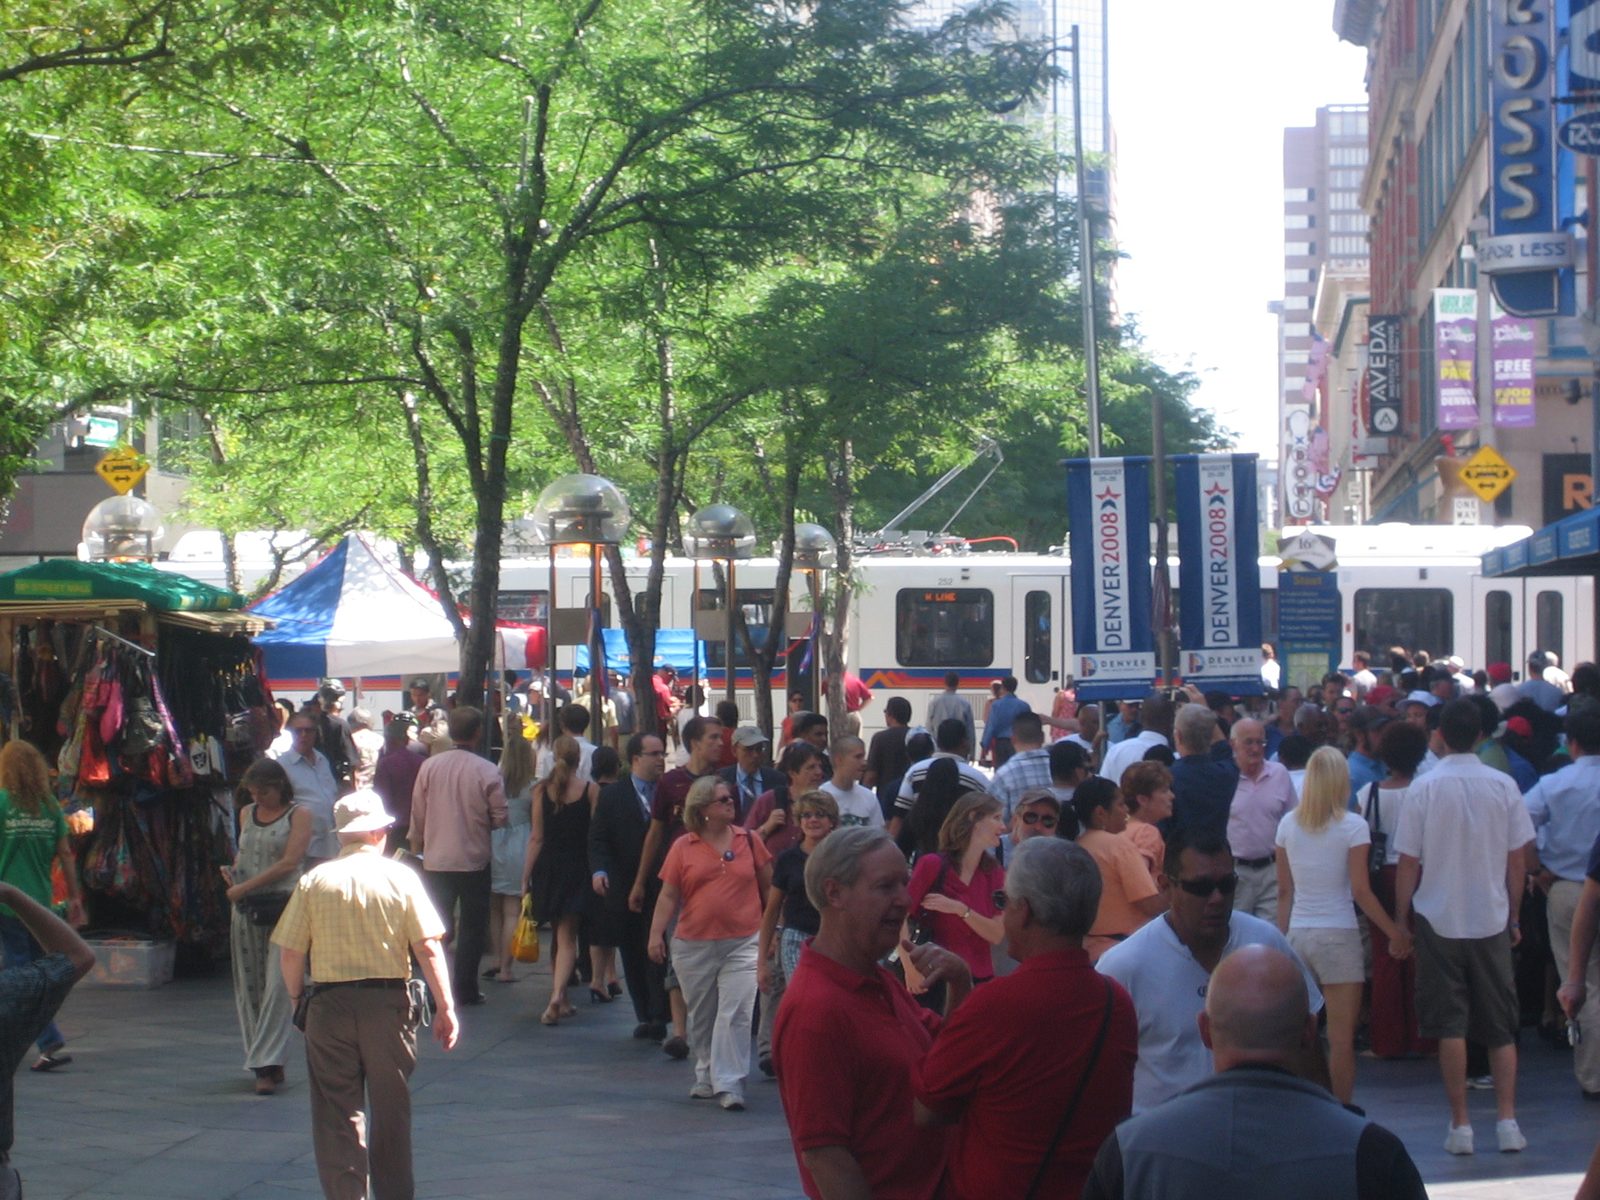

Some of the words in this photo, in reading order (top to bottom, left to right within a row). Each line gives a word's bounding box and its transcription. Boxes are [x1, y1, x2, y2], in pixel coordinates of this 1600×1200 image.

[1520, 242, 1567, 257] LESS
[1370, 320, 1387, 401] AVEDA
[1494, 359, 1532, 373] FREE
[1456, 500, 1476, 509] ONE
[1100, 512, 1122, 647] DENVER2008
[1208, 507, 1230, 643] DENVER2008
[1101, 659, 1147, 668] DENVER
[1208, 656, 1255, 664] DENVER
